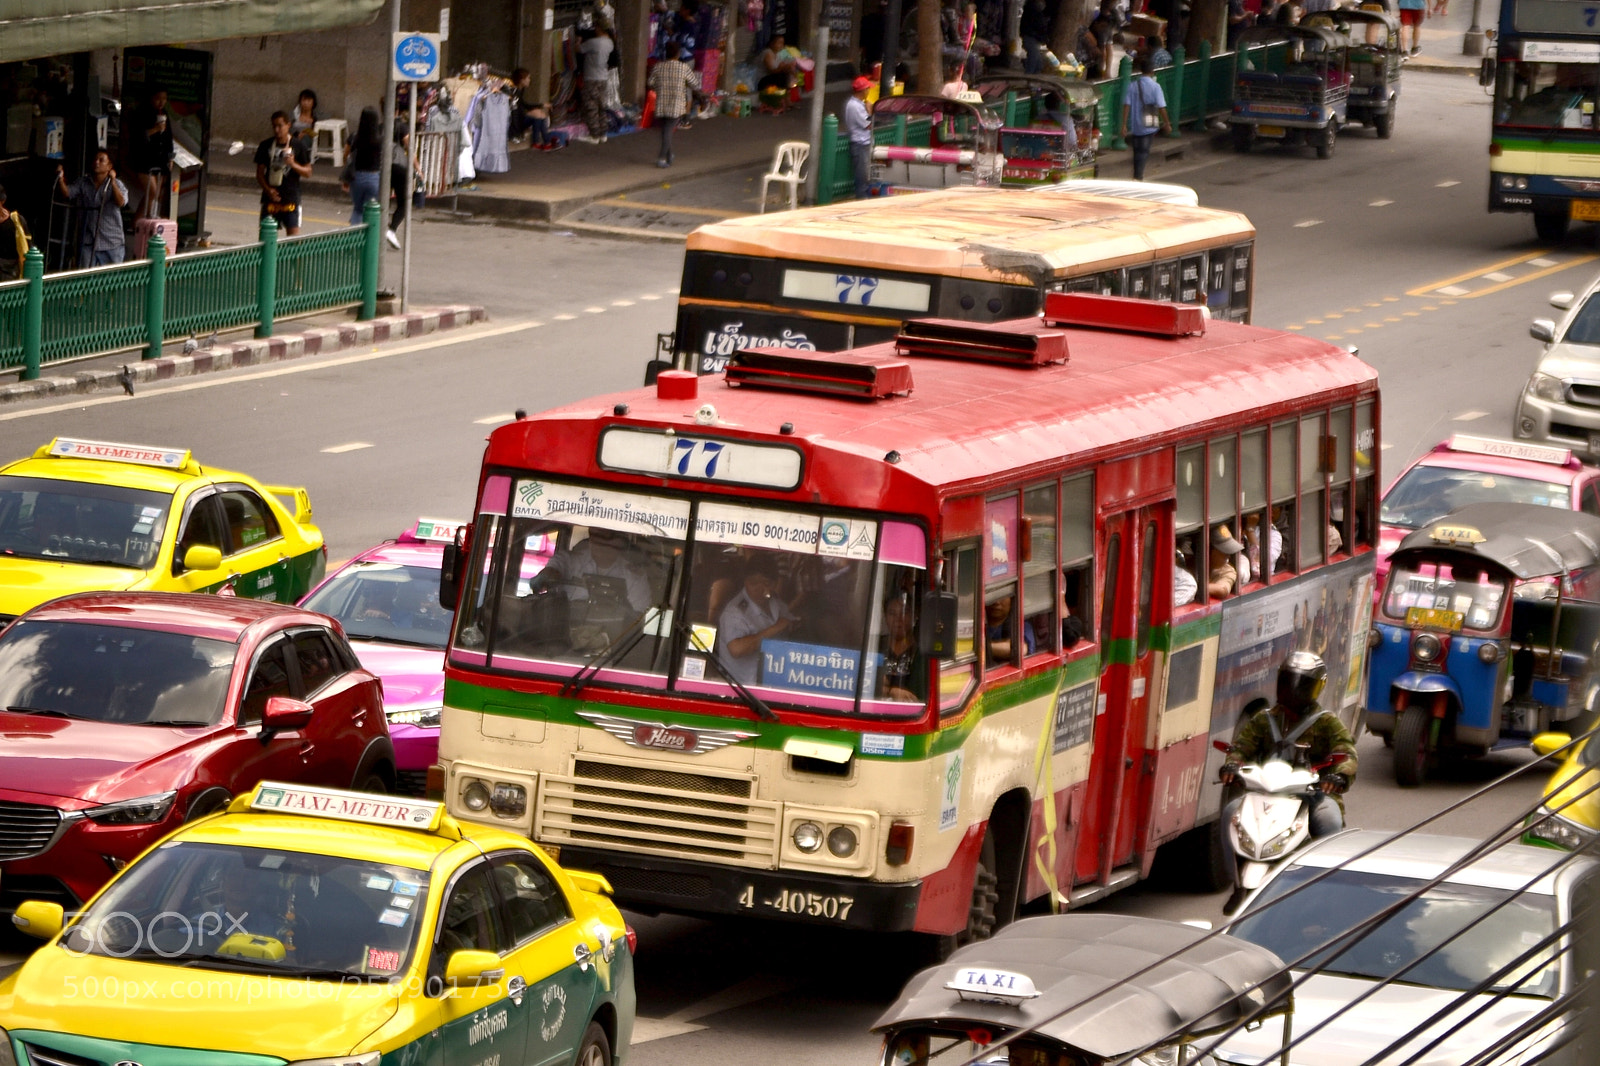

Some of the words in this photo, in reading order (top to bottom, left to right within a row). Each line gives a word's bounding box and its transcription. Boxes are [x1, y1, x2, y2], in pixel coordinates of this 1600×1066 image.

[1504, 197, 1533, 205] HINO
[835, 274, 879, 306] 77
[75, 444, 163, 462] TAXI-METER
[674, 437, 725, 479] 77
[1482, 442, 1561, 462] TAXI-METER
[514, 505, 542, 517] BMTA
[742, 521, 760, 537] ISO
[764, 524, 818, 545] 9001:2008
[1441, 528, 1471, 539] TAXI
[765, 653, 785, 675] ไป
[788, 651, 855, 671] หมอชิต
[787, 669, 854, 691] Morchit
[645, 728, 686, 747] Hino
[284, 792, 411, 822] TAXI-METER
[739, 886, 755, 908] 4
[369, 948, 400, 971] TAXI
[967, 971, 1016, 989] TAXI
